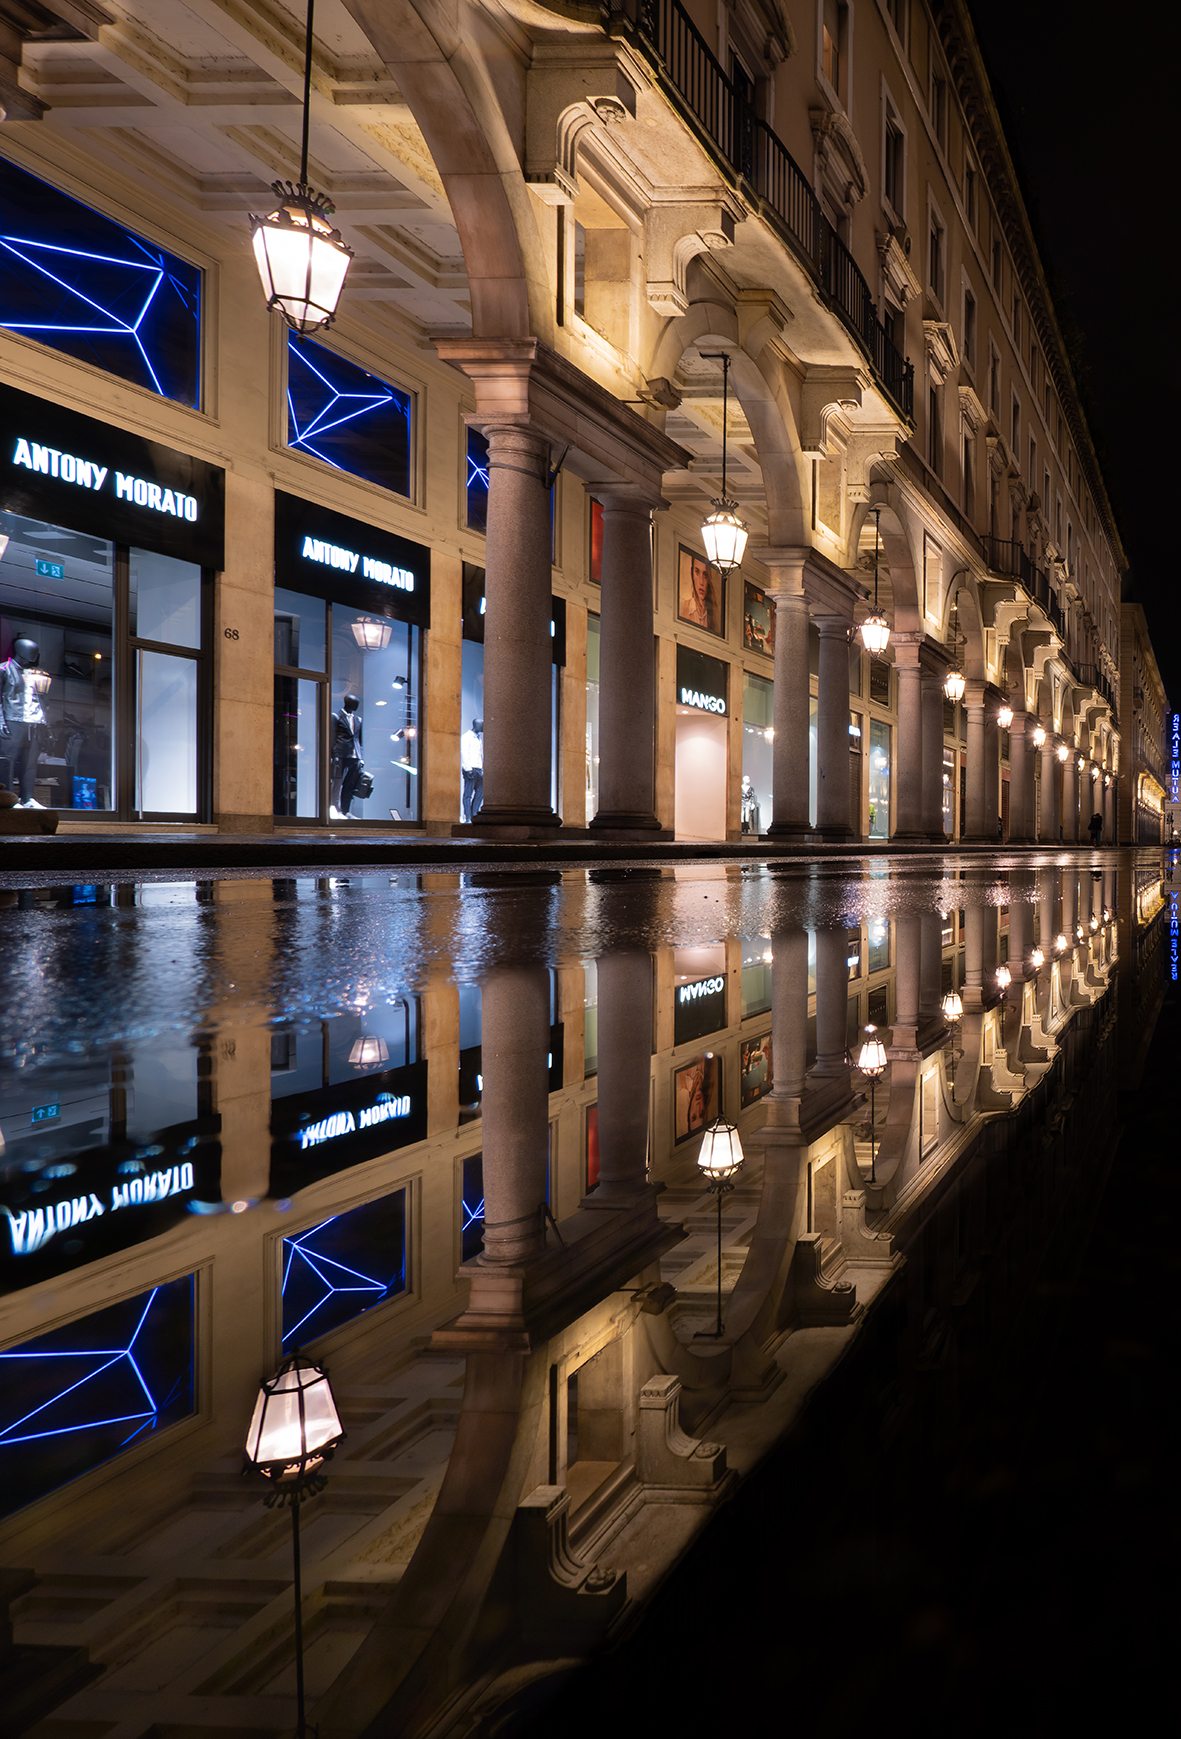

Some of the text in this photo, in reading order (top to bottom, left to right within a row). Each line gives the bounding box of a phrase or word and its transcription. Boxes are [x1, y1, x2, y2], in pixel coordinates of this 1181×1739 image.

[13, 437, 198, 522] ANTONY MORATO
[302, 536, 415, 593] ANTONY MORATO
[224, 627, 240, 641] 68
[681, 687, 726, 714] MANGO
